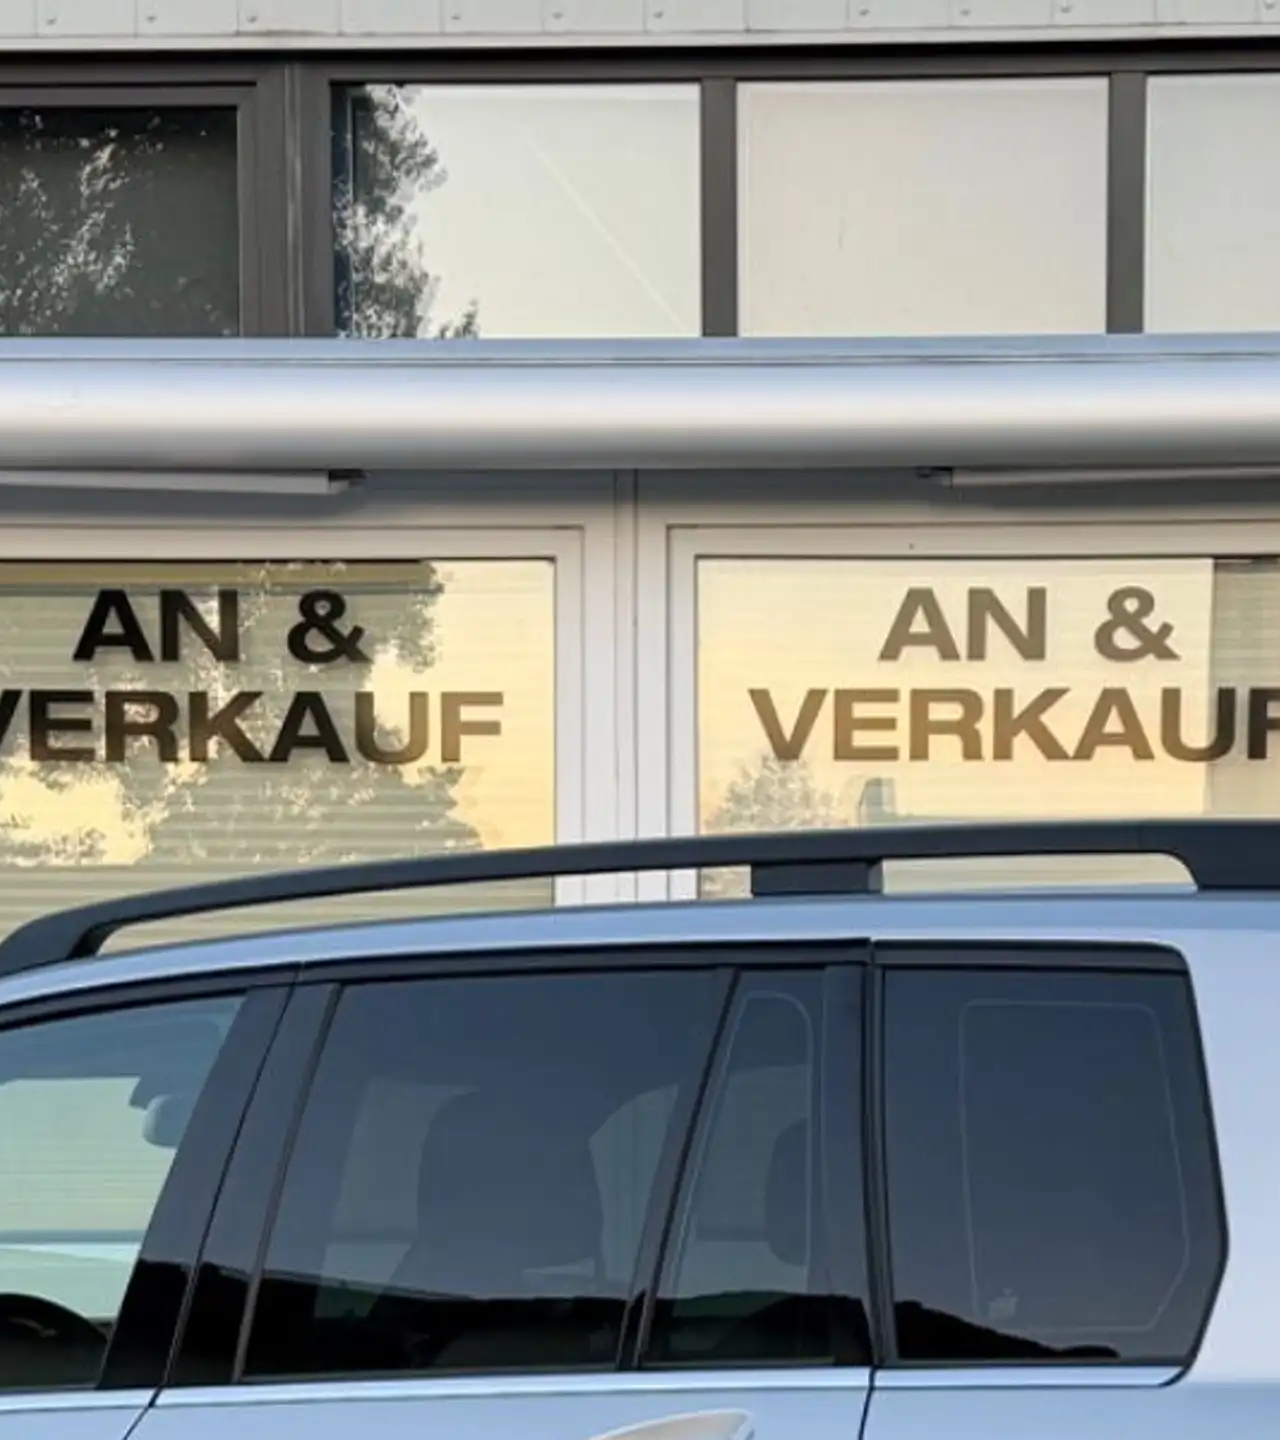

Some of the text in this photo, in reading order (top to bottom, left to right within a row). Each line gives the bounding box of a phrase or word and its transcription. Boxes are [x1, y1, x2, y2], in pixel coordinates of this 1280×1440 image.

[72, 589, 372, 663] AN &
[878, 587, 1181, 662] AN &
